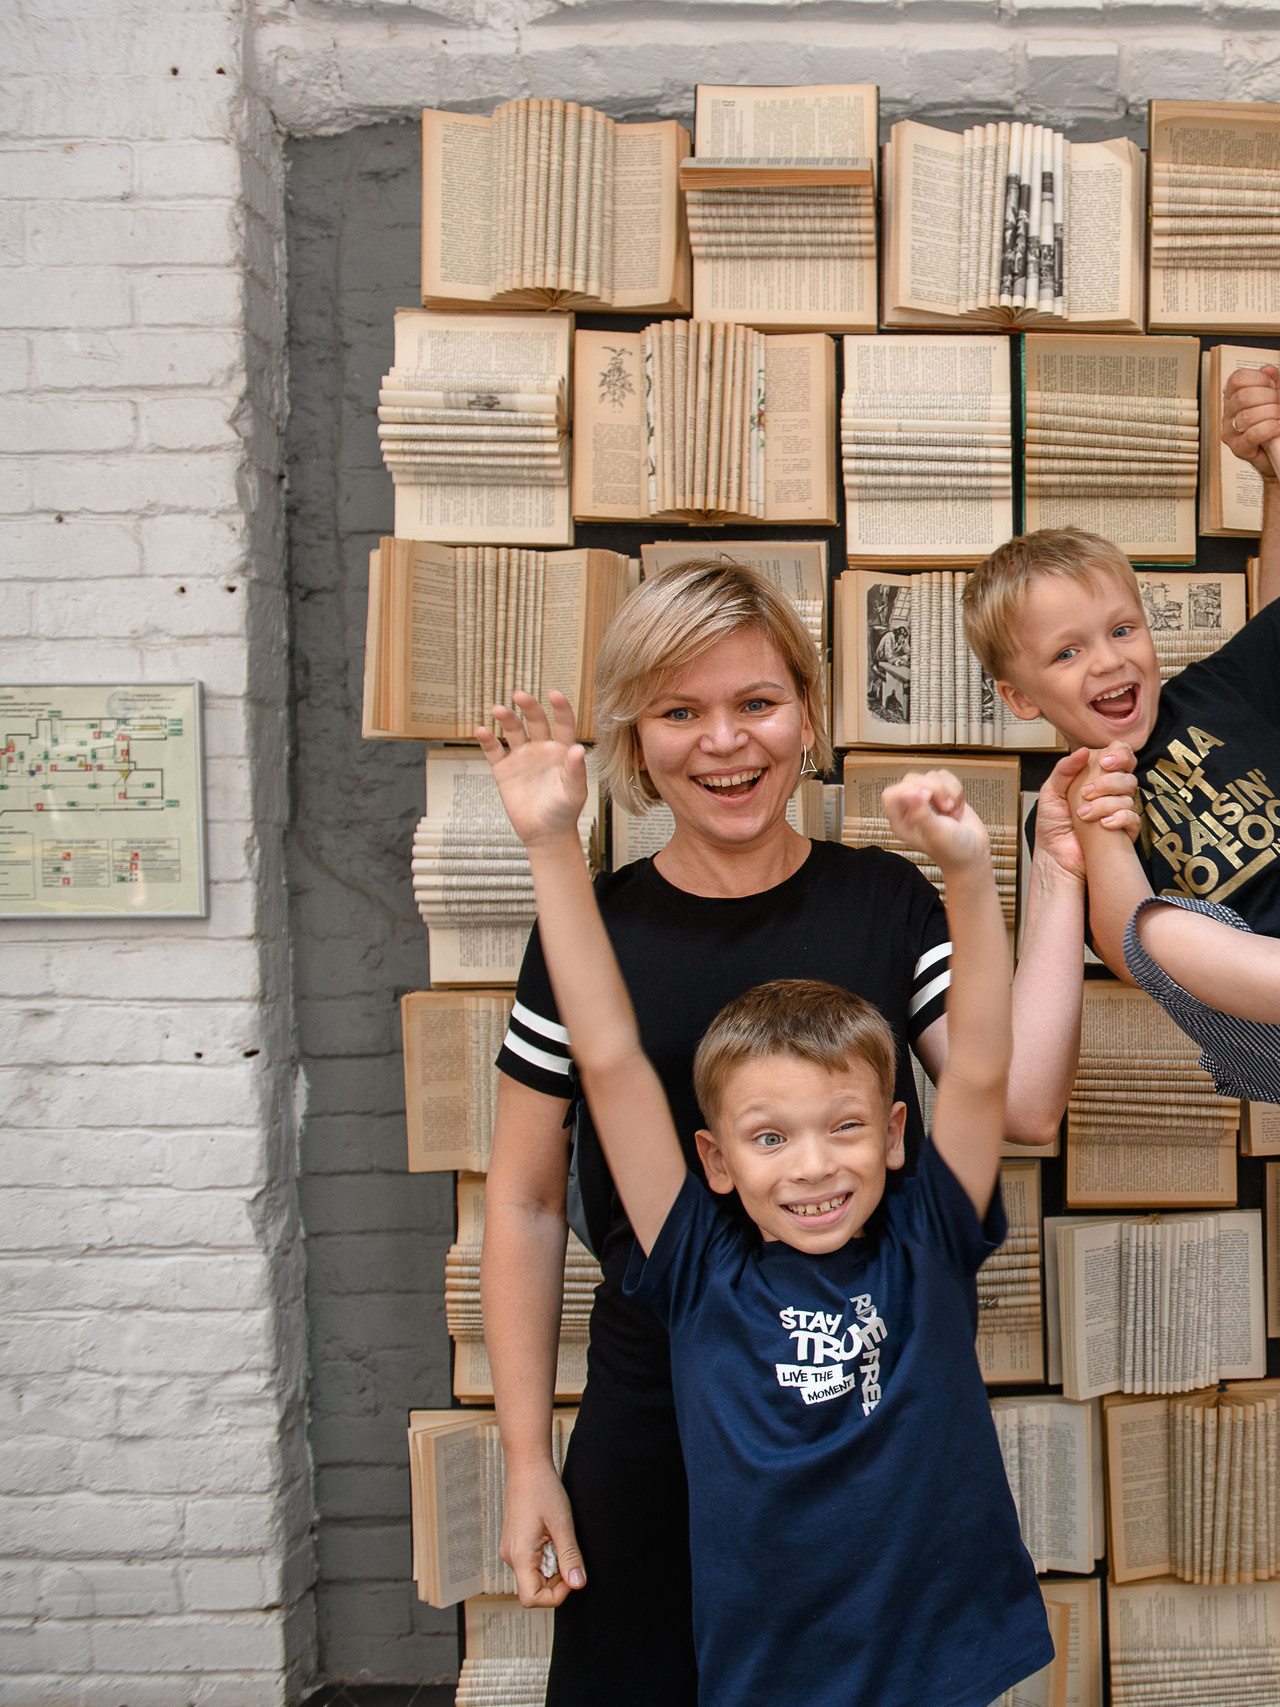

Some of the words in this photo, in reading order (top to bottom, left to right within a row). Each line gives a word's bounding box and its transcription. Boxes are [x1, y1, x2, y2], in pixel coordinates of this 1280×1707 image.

[1154, 768, 1275, 873] RAISIN'
[779, 1306, 843, 1335] STAY
[782, 1369, 809, 1383] LIVE
[811, 1370, 834, 1383] THE
[807, 1378, 852, 1401] MOMENT
